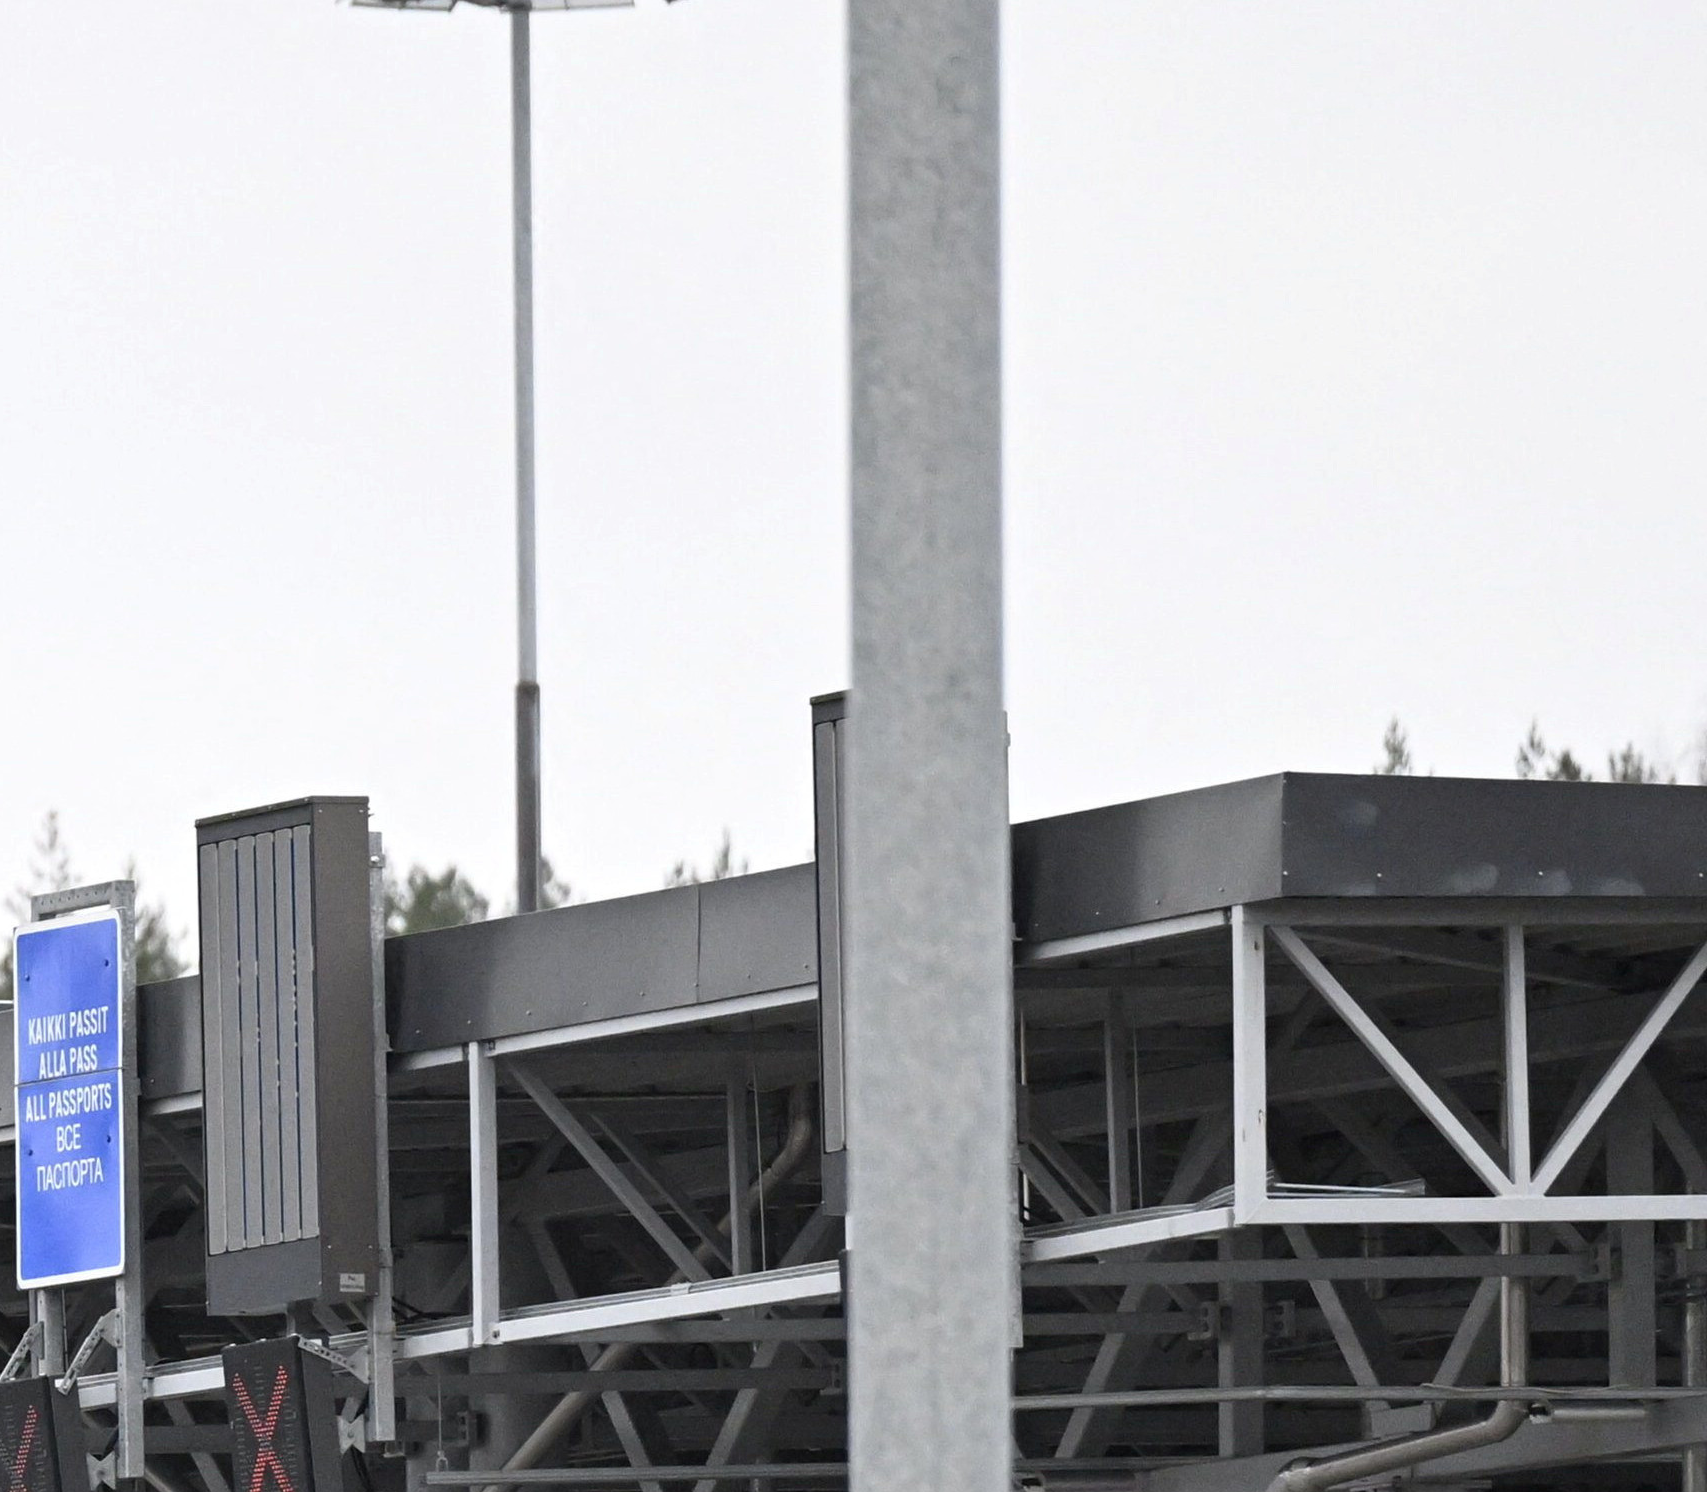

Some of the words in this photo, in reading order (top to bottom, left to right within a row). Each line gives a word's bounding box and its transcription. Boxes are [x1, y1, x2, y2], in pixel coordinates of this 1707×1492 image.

[28, 1013, 66, 1045] KAIKKI
[69, 1005, 109, 1039] PASSIT
[38, 1049, 66, 1080] ALLA
[69, 1043, 98, 1074] PASS
[25, 1090, 47, 1123] ALL
[48, 1082, 113, 1119] PASSPORTS
[56, 1123, 82, 1153] ВСЕ
[36, 1157, 104, 1192] ПАСПОРТА
